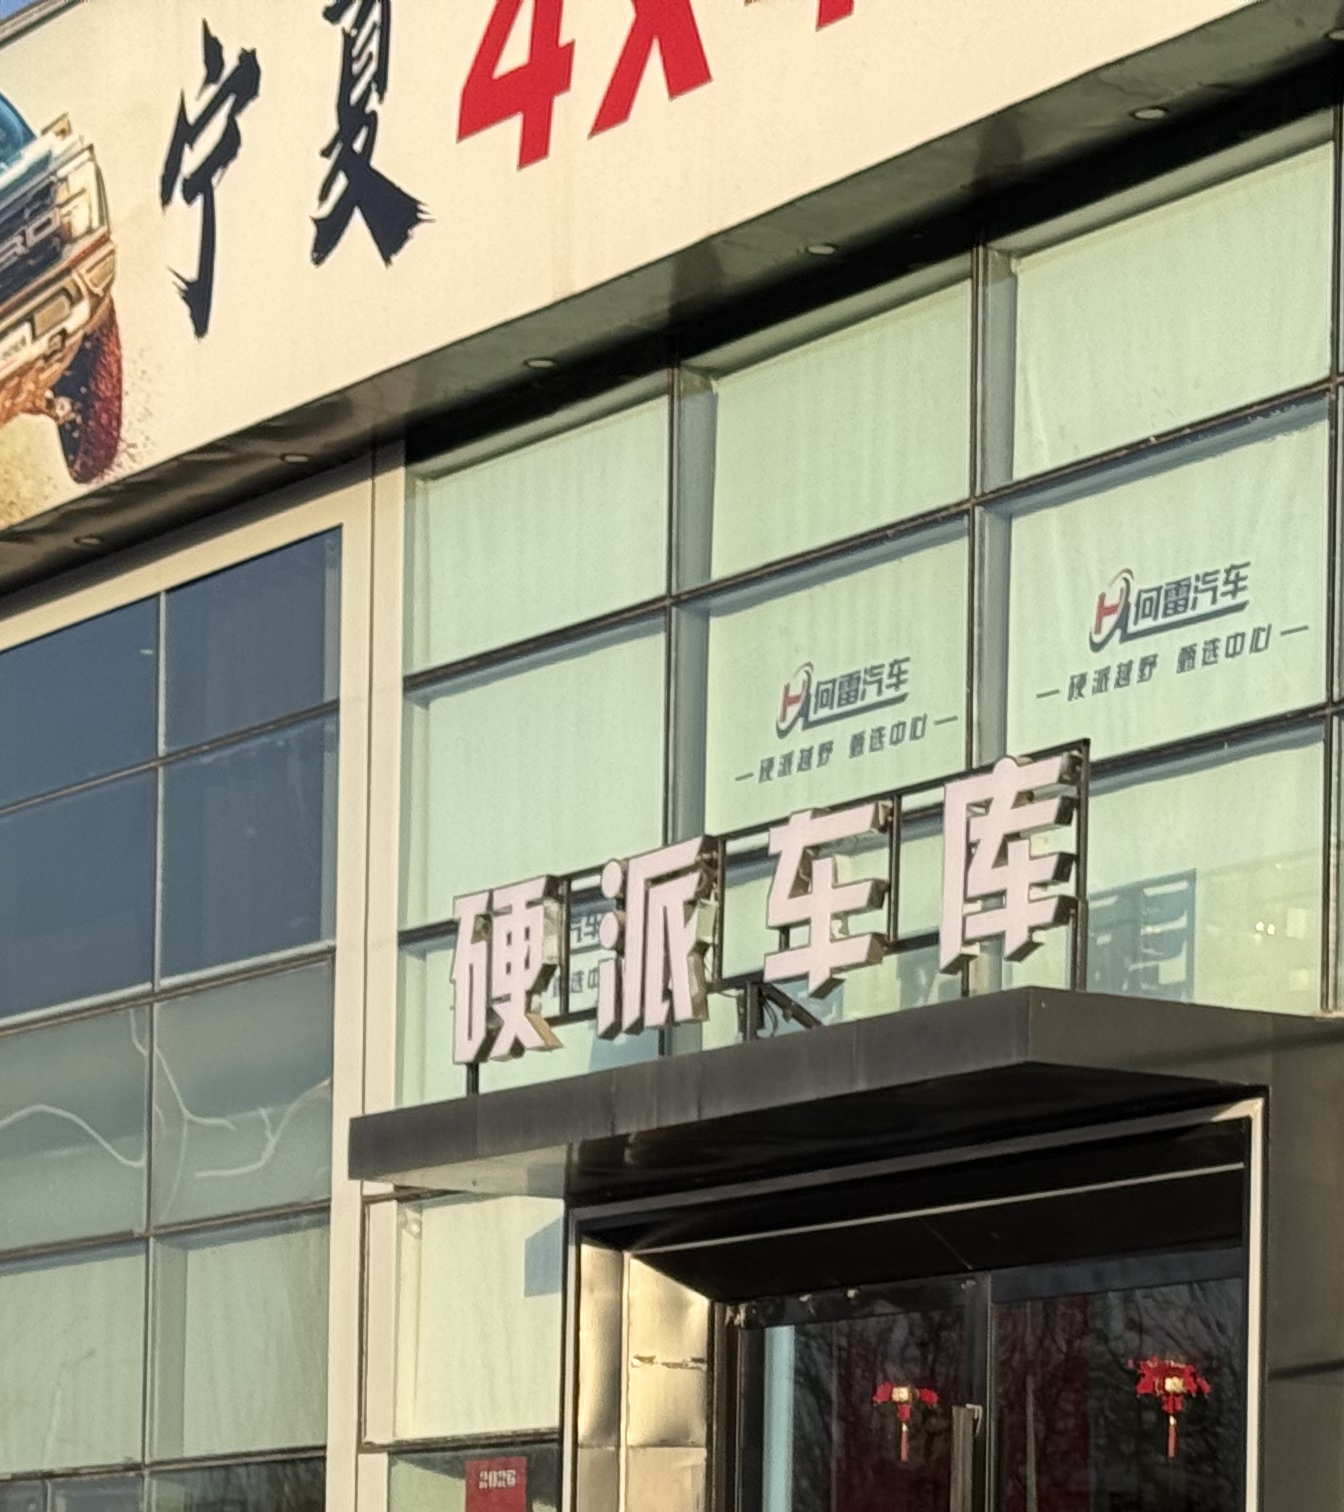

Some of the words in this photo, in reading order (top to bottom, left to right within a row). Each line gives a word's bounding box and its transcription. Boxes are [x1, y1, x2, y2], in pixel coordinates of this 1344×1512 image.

[160, 0, 436, 341] 宁夏
[456, 0, 855, 171] 4X
[814, 657, 911, 714] 何雷汽车
[1133, 561, 1251, 626] 何雷汽车
[451, 755, 1080, 1064] 硬派车库
